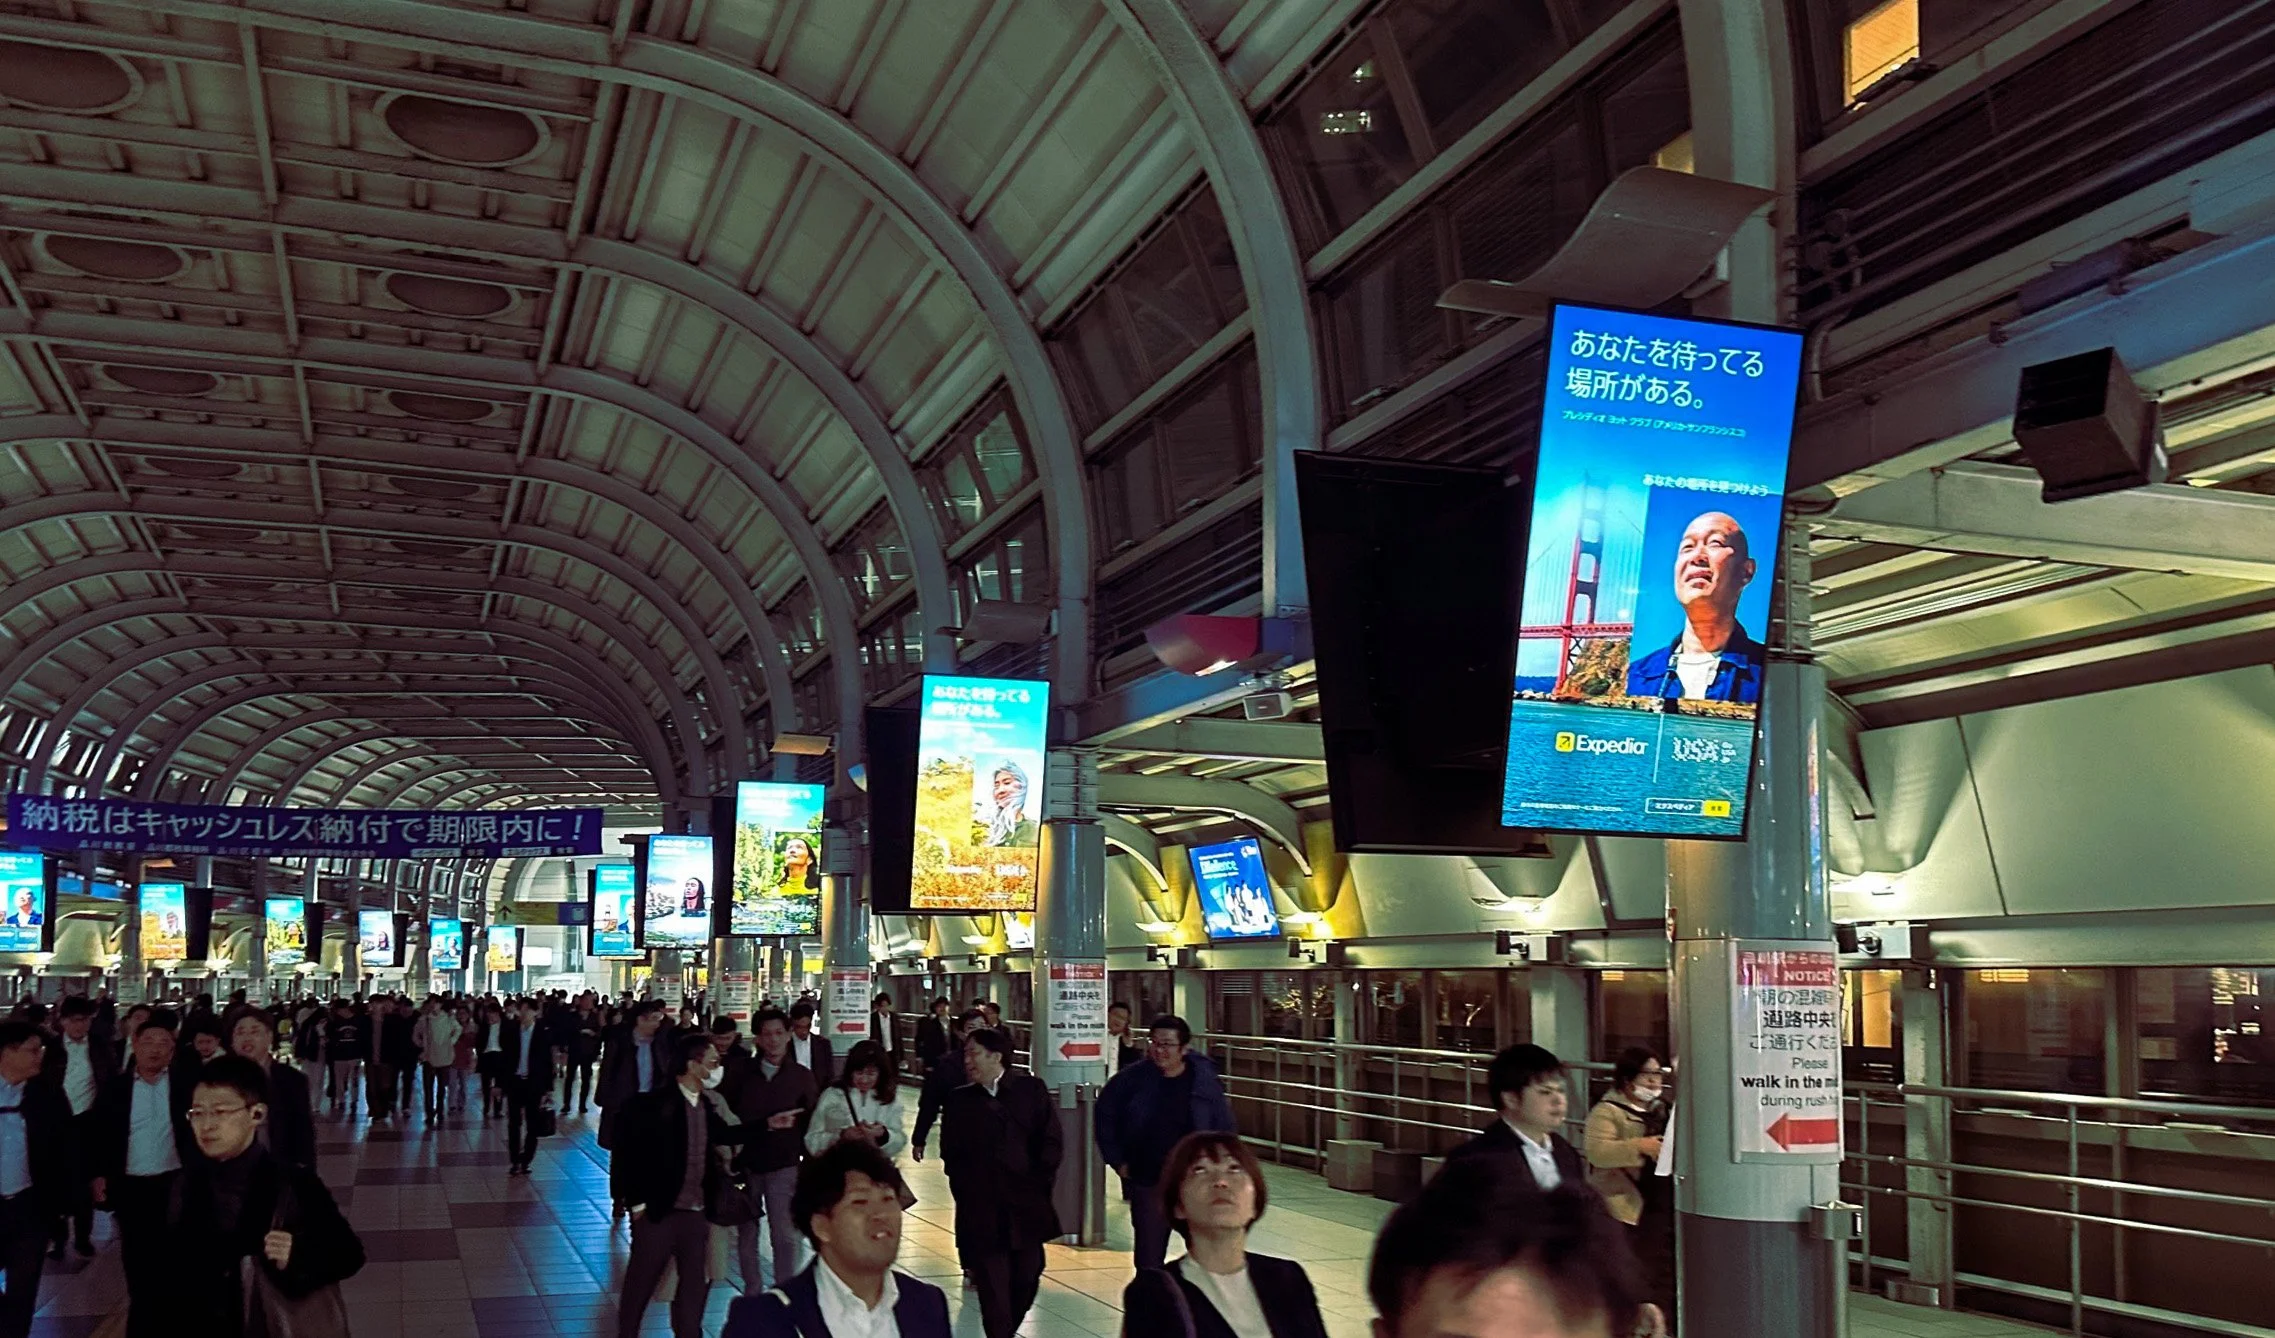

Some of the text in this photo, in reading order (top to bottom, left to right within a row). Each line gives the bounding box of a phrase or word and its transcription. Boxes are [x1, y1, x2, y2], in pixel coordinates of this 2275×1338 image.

[1570, 329, 1764, 378] あなたを待ってる
[1565, 366, 1704, 409] 場所がある。
[1577, 734, 1648, 756] Expedia
[1784, 970, 1831, 982] NOTICE
[1792, 1057, 1828, 1069] Please
[1741, 1075, 1781, 1088] walk
[1785, 1075, 1799, 1088] in
[1803, 1075, 1823, 1088] the
[1761, 1094, 1802, 1109] during
